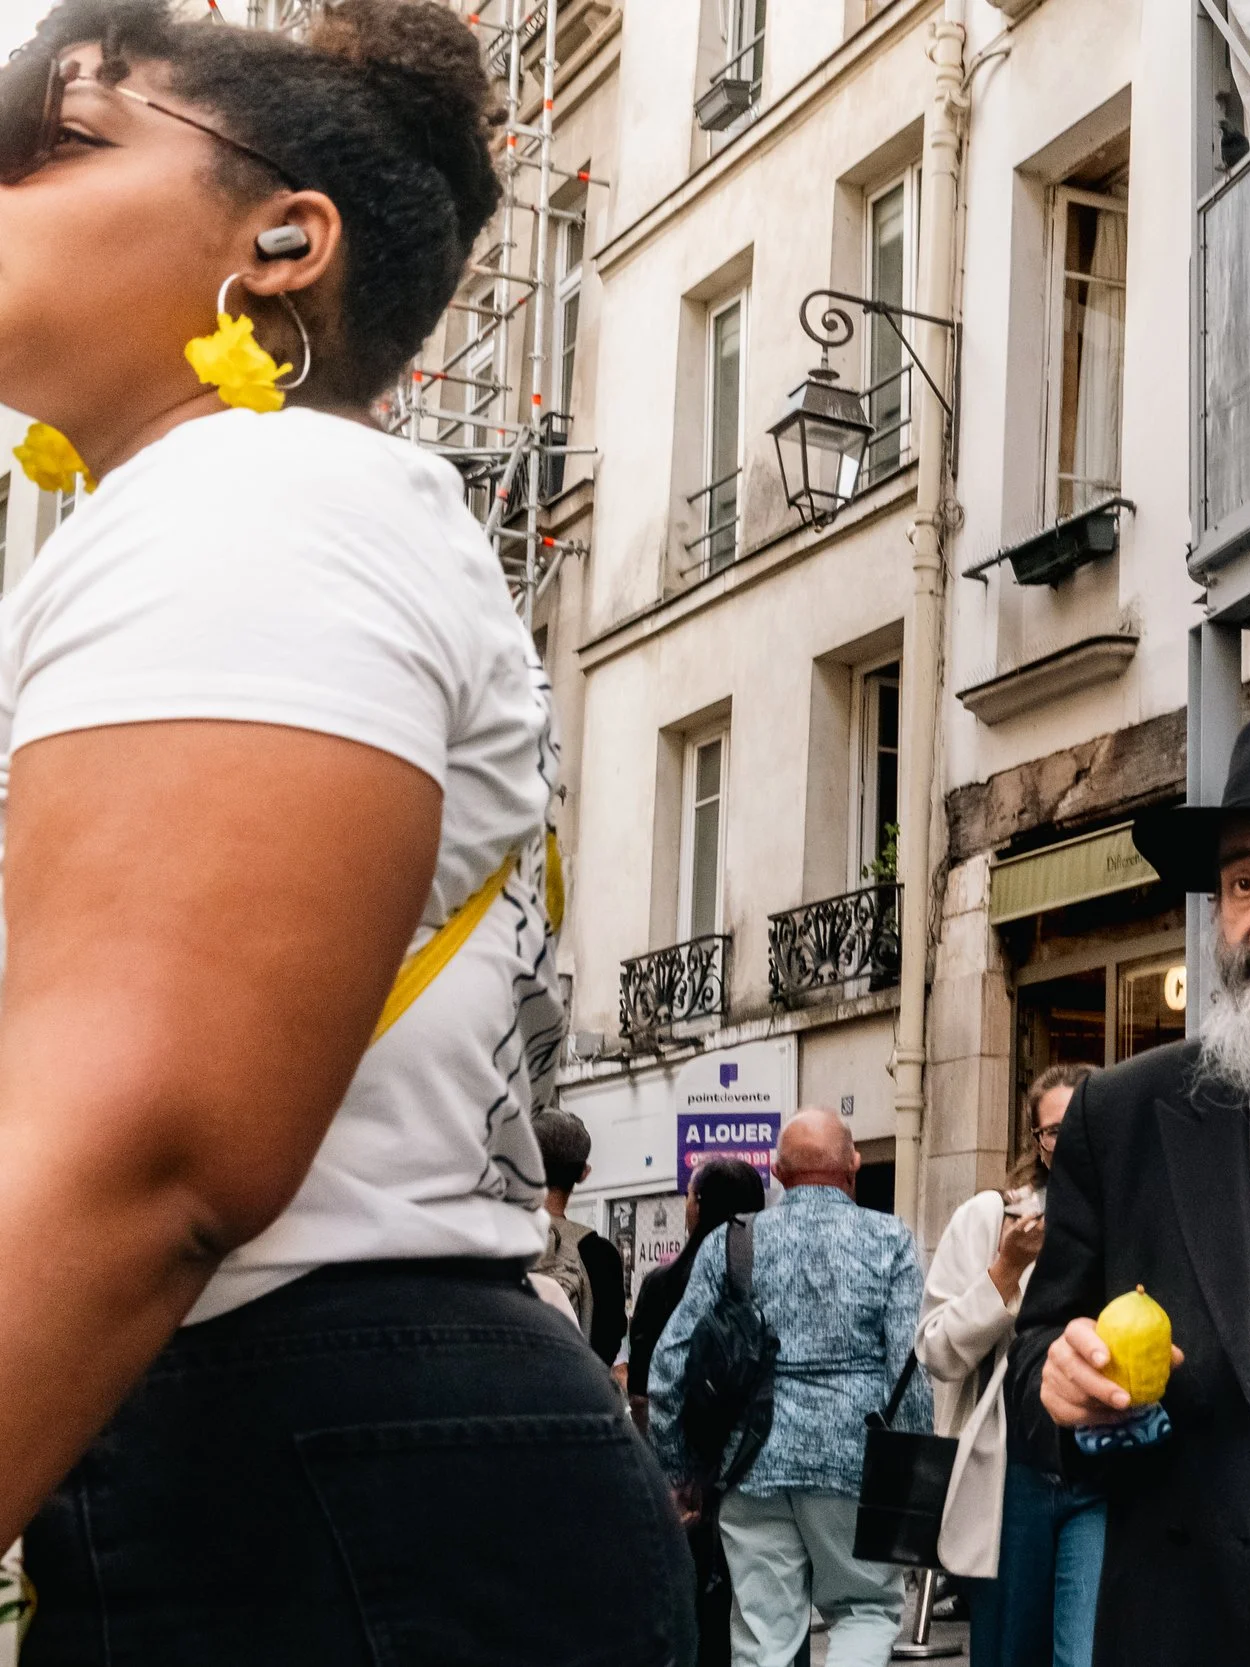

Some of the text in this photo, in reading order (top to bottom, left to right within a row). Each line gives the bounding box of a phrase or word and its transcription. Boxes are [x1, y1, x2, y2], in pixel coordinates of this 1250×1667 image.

[688, 1092, 770, 1106] pointdevente
[685, 1123, 772, 1143] A LOUER
[640, 1242, 646, 1262] A
